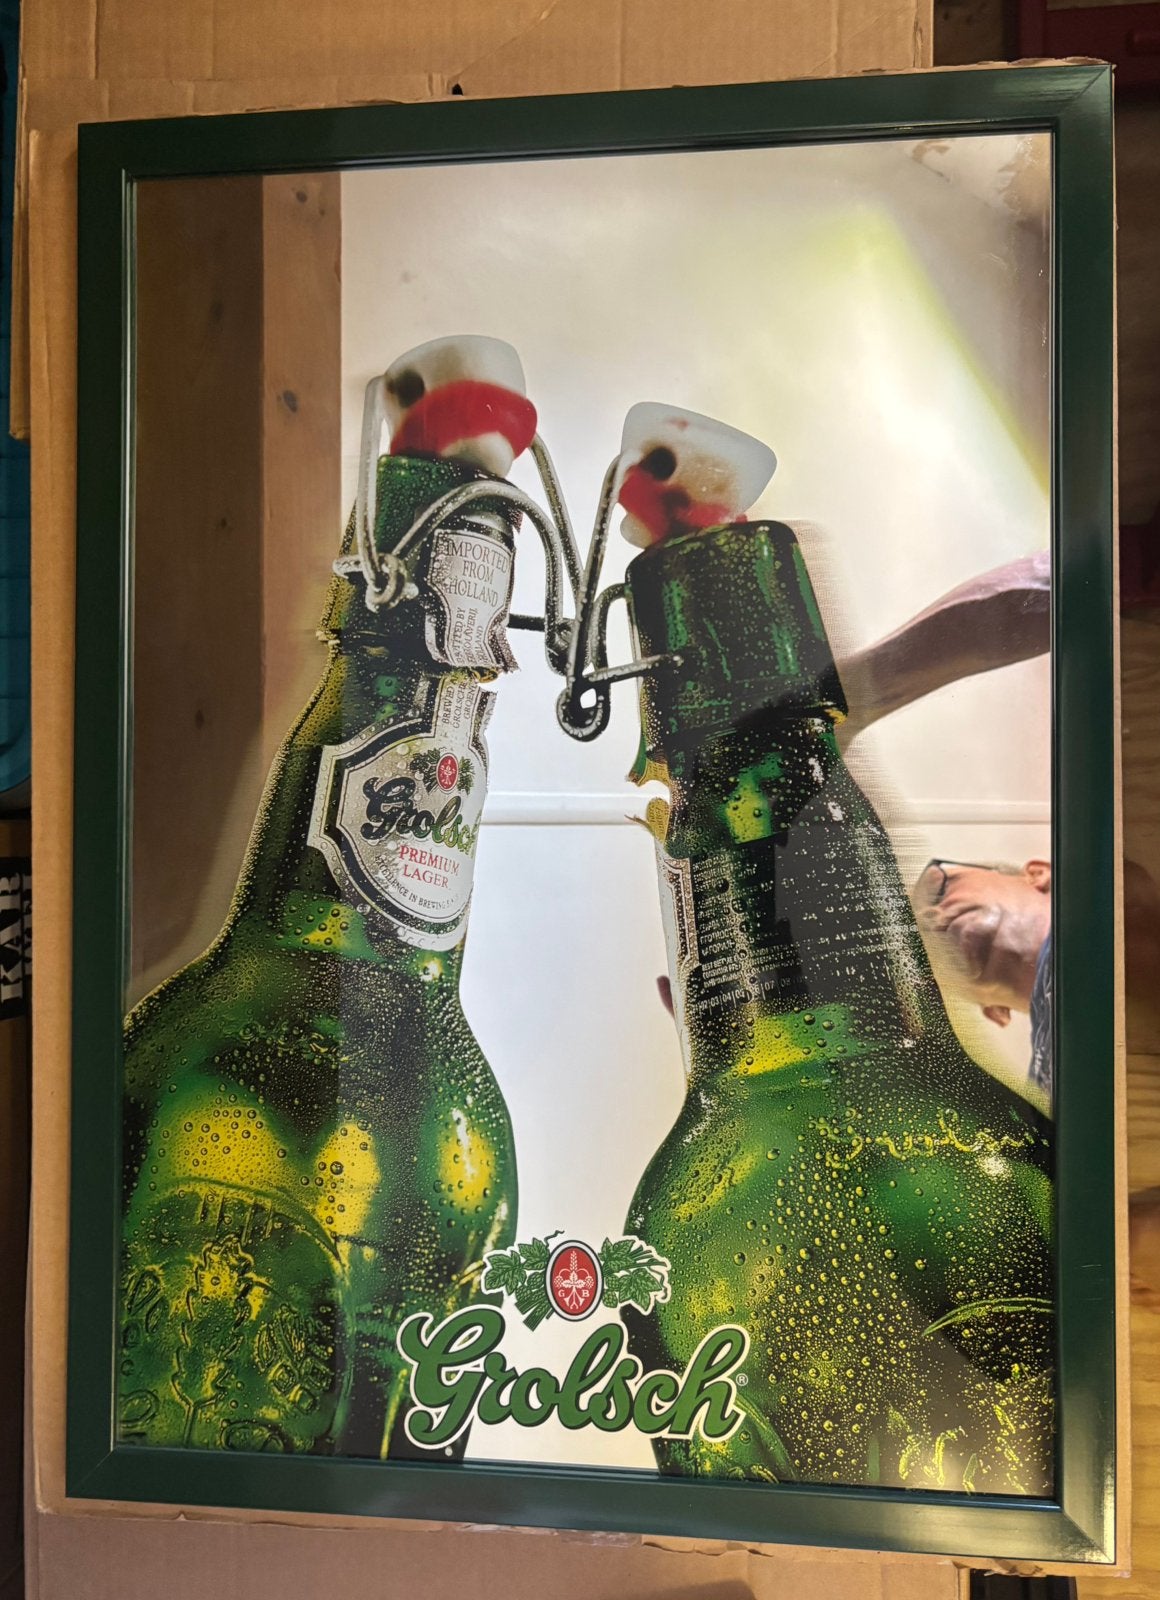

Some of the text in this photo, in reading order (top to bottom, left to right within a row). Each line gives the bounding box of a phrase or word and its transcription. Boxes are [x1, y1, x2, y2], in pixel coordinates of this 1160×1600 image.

[447, 538, 508, 574] IMPORTED
[462, 560, 494, 585] FROM
[445, 578, 500, 609] HOLLAND
[442, 685, 456, 724] BREWED
[457, 607, 466, 620] BY
[399, 845, 460, 876] PREMIUM
[402, 864, 449, 889] LAGER
[408, 893, 418, 903] IN
[397, 1305, 748, 1447] Grolsch
